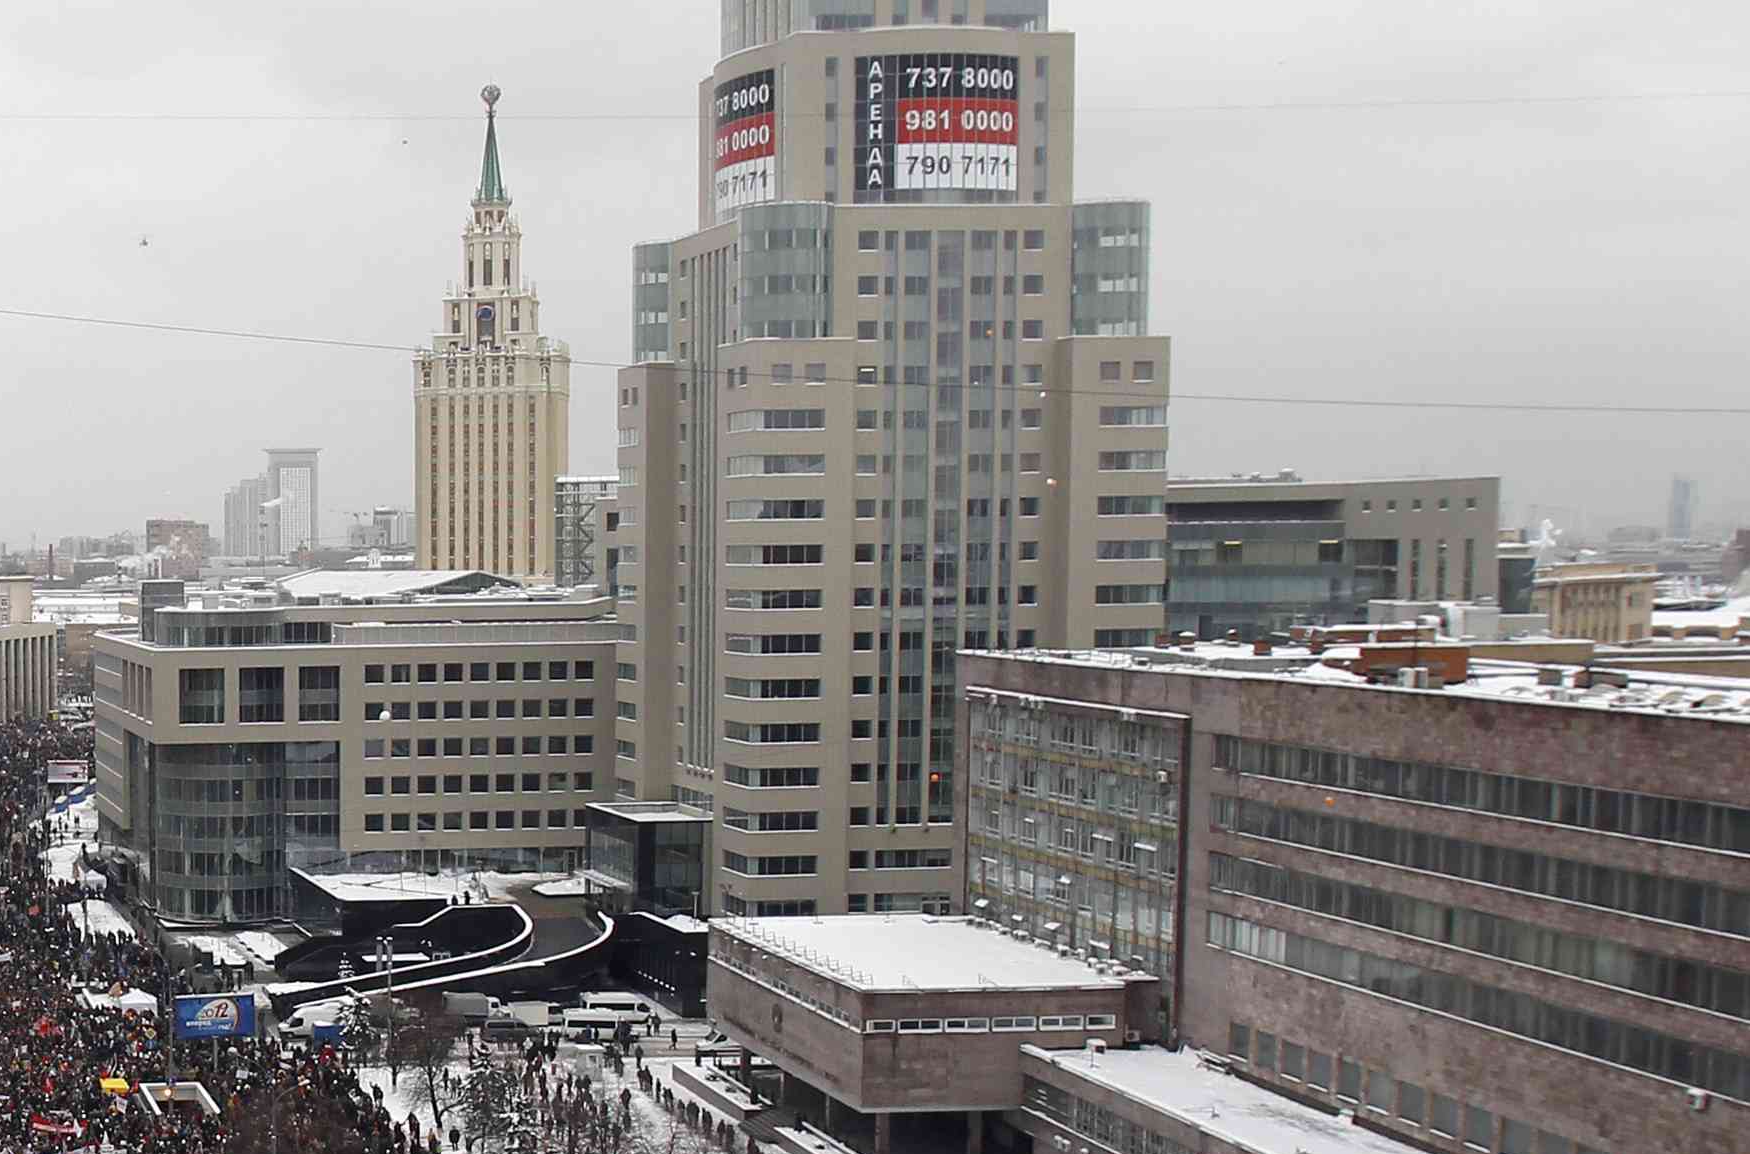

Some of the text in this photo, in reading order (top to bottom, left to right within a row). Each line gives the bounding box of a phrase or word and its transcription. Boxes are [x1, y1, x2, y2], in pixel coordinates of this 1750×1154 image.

[906, 67, 1014, 89] 737 8000
[732, 83, 770, 111] 8000
[906, 110, 1013, 132] 981 0000
[732, 124, 770, 151] 0000
[906, 155, 1011, 175] 790 7171
[731, 169, 768, 195] 7171
